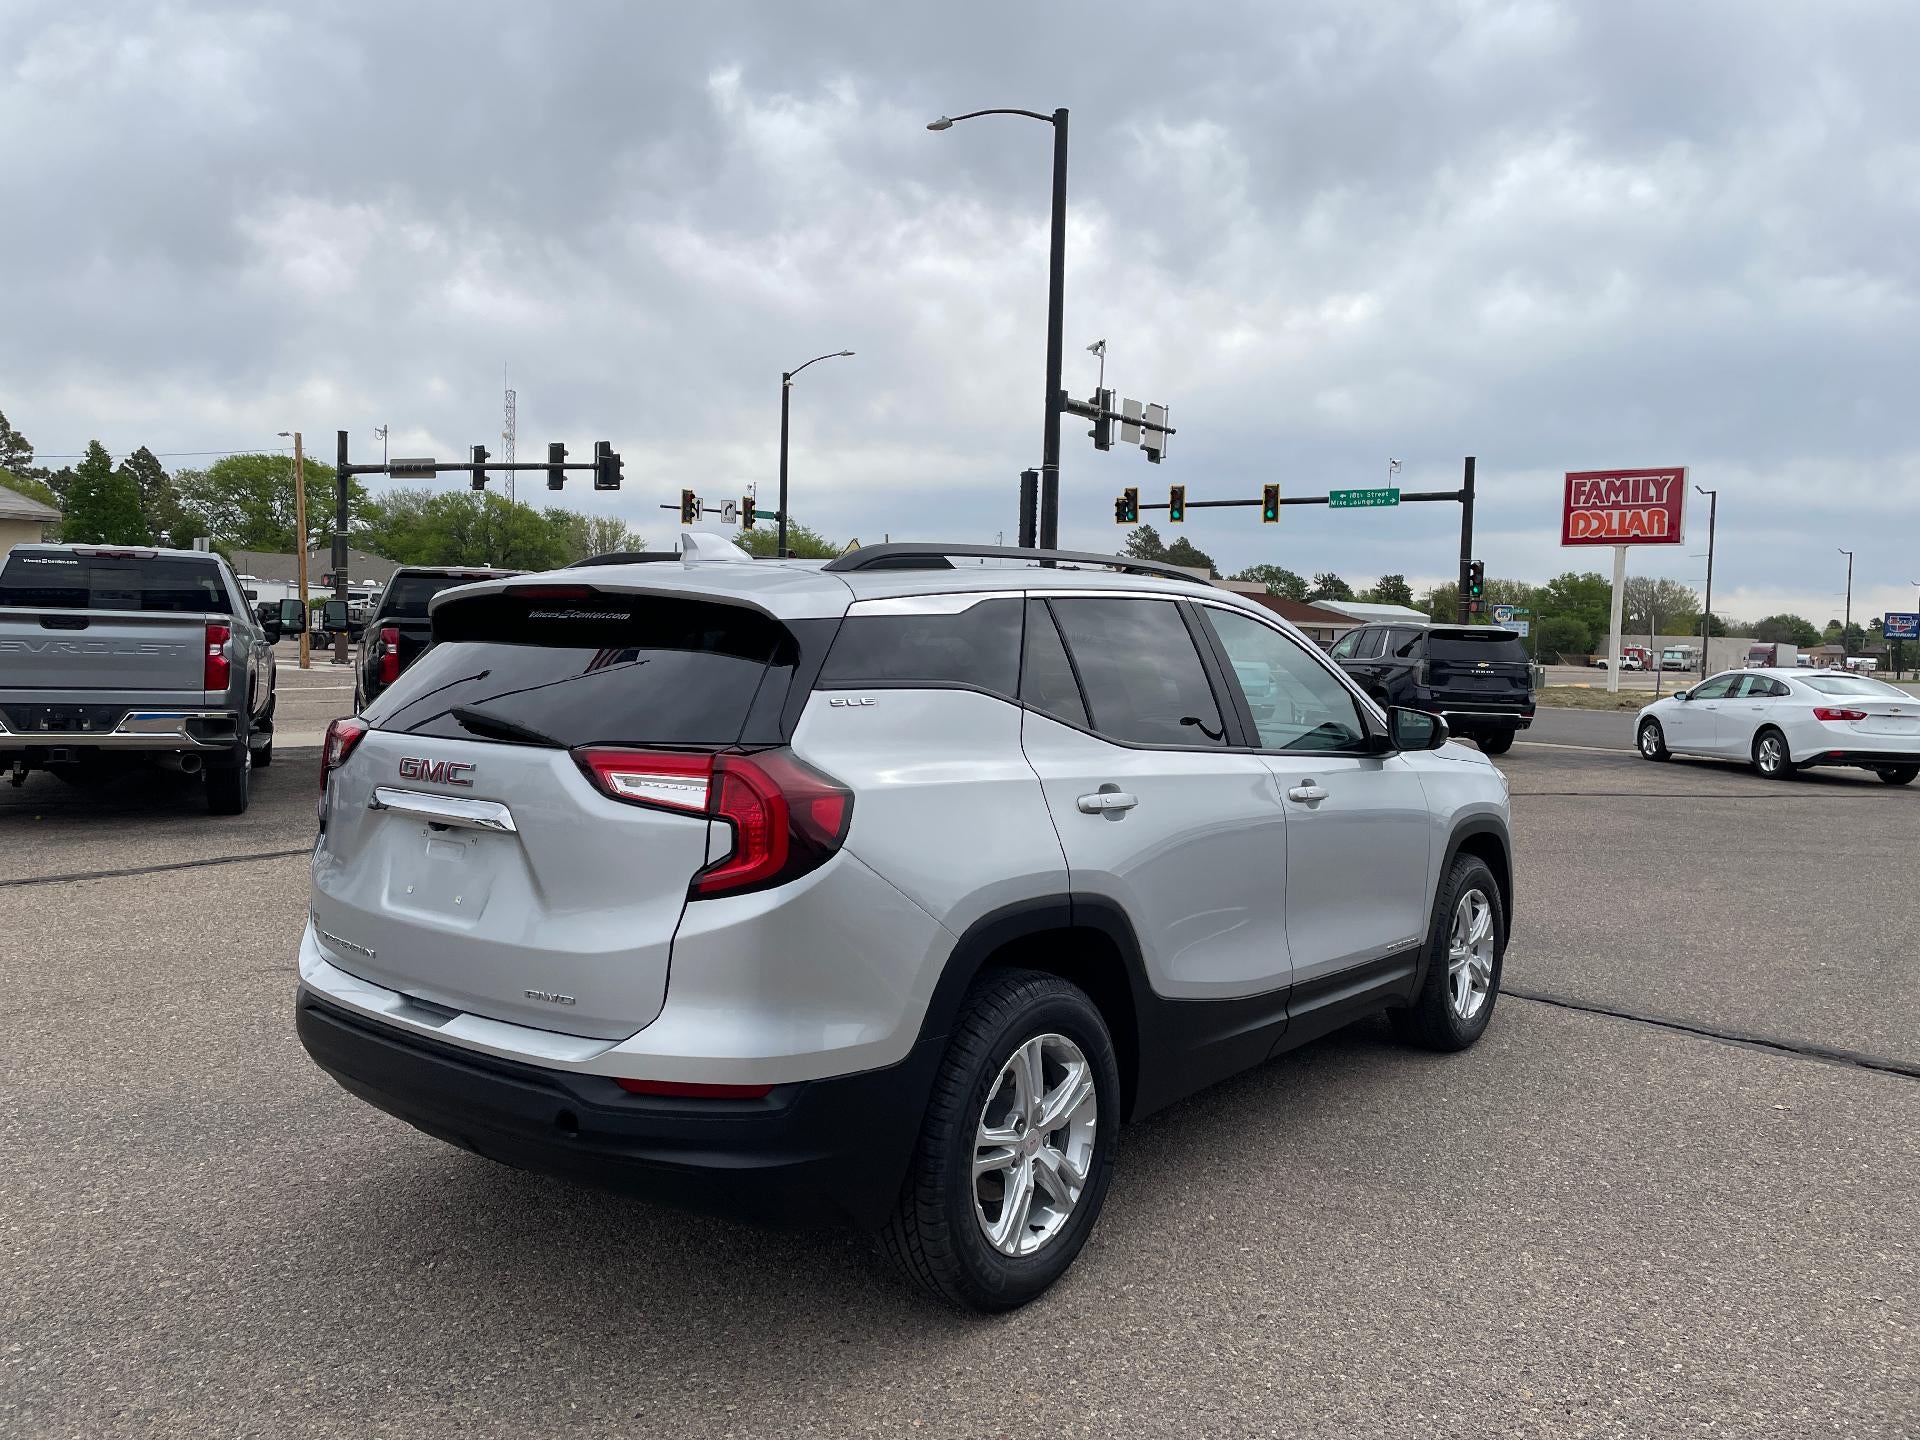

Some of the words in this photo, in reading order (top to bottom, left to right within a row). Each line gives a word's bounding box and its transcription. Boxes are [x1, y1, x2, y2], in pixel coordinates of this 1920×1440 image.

[1571, 476, 1675, 507] FAMILY
[1569, 508, 1669, 538] DOLLAR
[829, 698, 876, 707] SLE
[399, 756, 475, 787] GMC
[523, 989, 576, 1005] AWD
